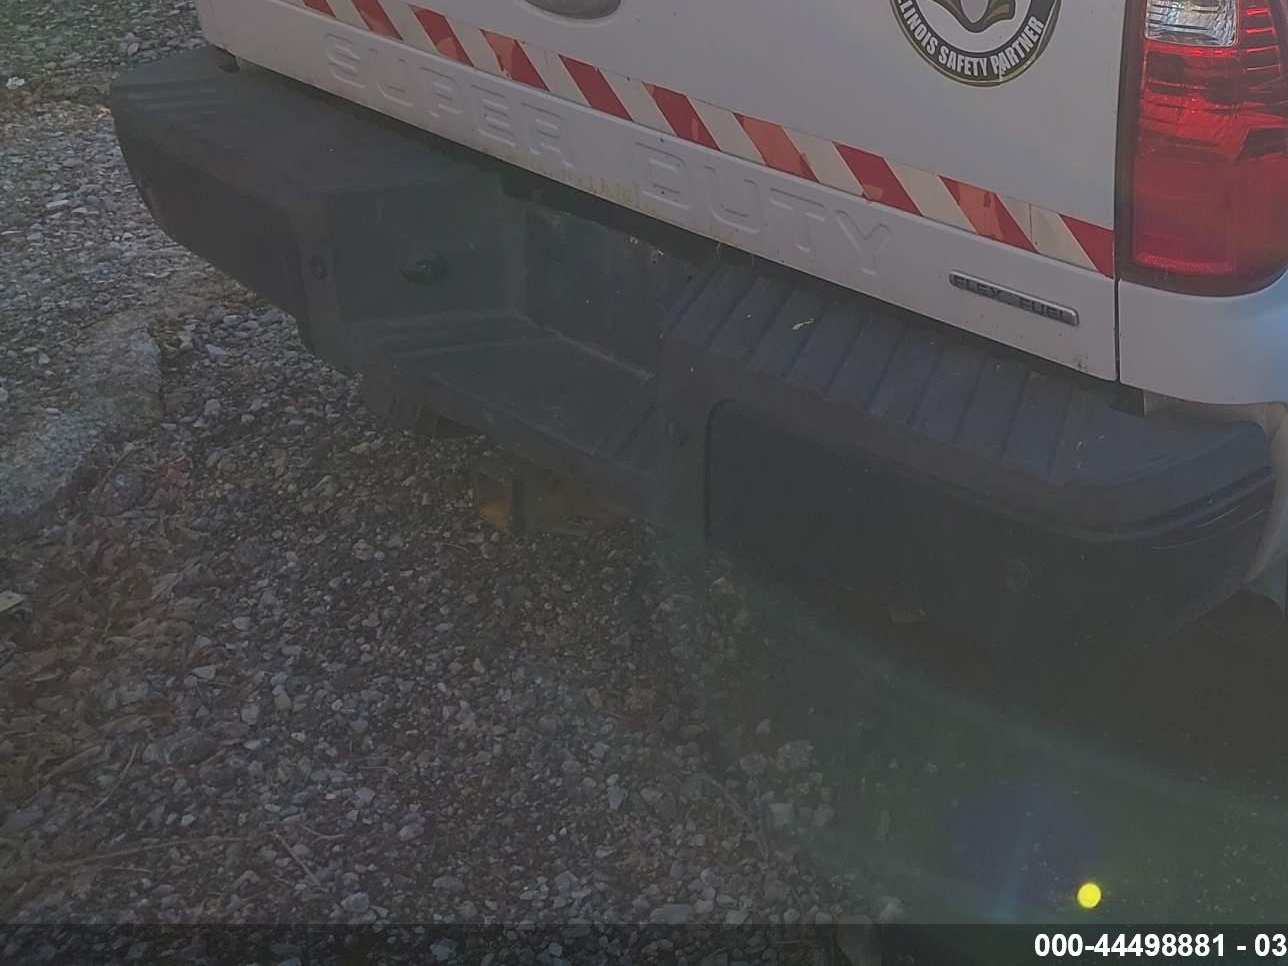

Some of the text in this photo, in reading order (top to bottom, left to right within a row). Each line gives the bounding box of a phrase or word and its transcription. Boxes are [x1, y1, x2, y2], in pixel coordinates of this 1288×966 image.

[938, 47, 989, 77] SAFETY
[989, 16, 1045, 76] PARTNER
[325, 33, 891, 276] SUPER DUTY
